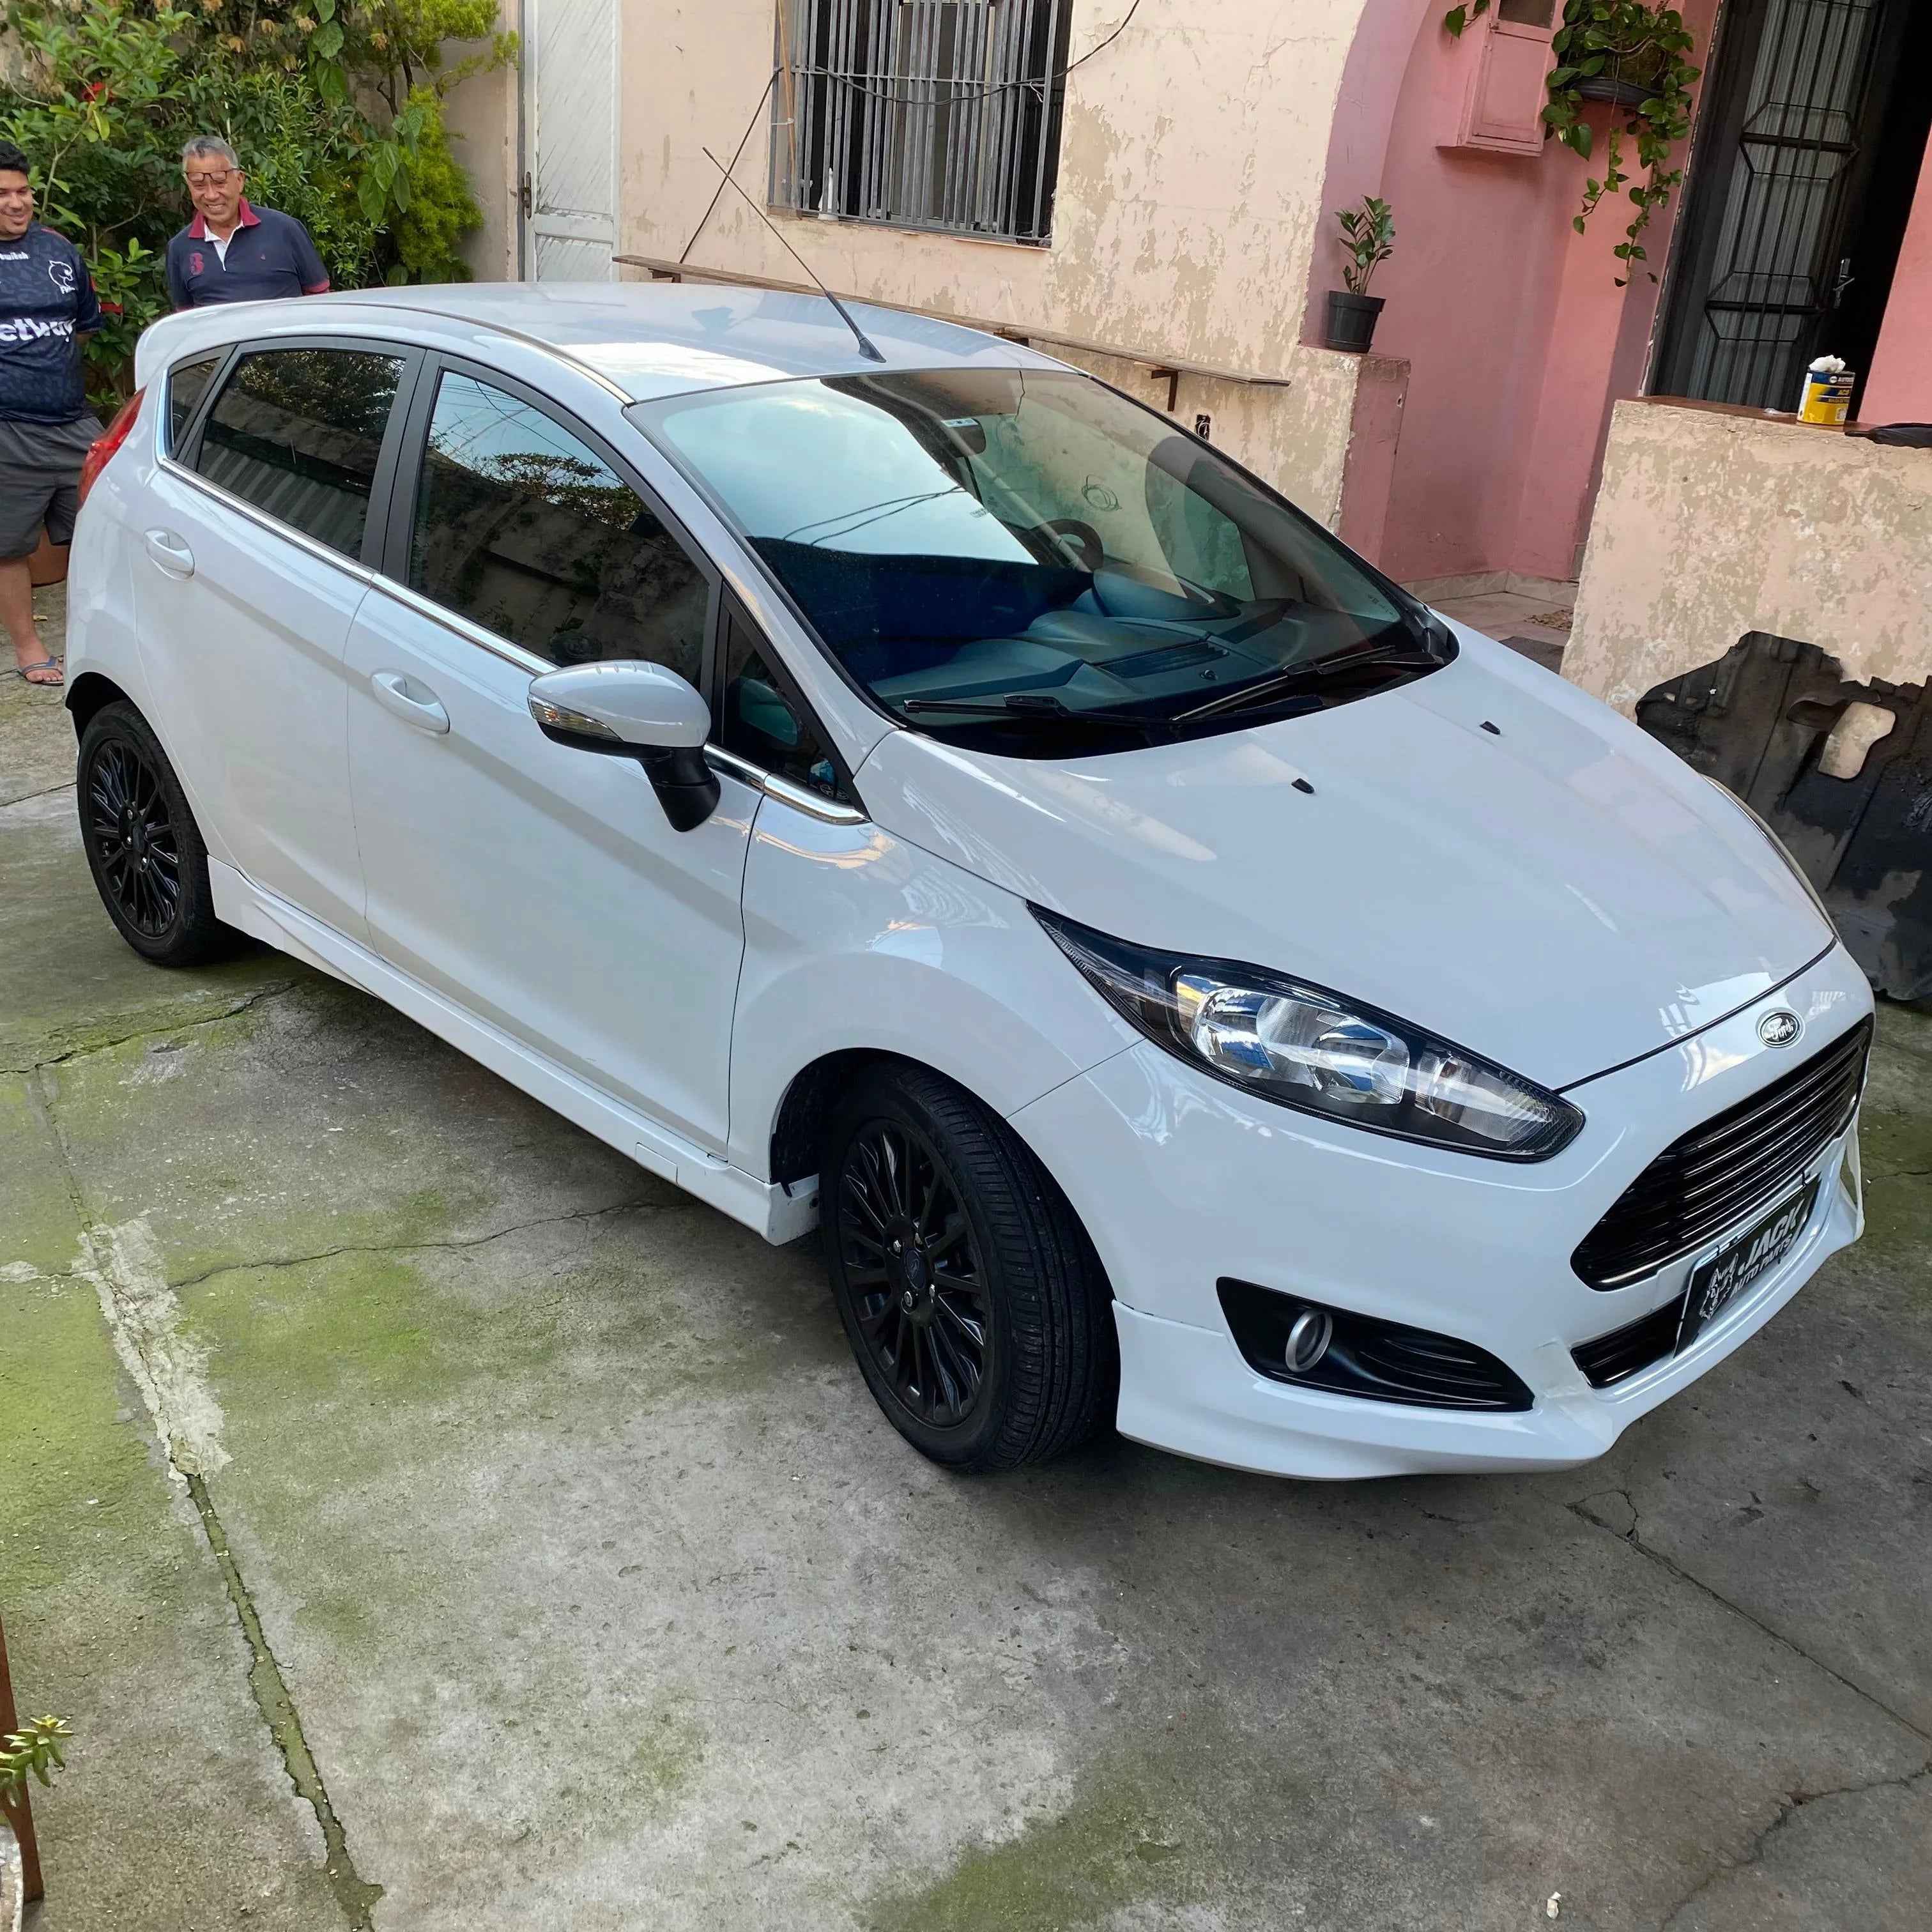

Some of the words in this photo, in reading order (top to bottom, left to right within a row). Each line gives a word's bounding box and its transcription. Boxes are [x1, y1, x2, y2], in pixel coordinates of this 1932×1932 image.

[0, 318, 76, 342] etway
[1738, 1198, 1805, 1276] JACK
[1729, 1264, 1759, 1299] AUTO
